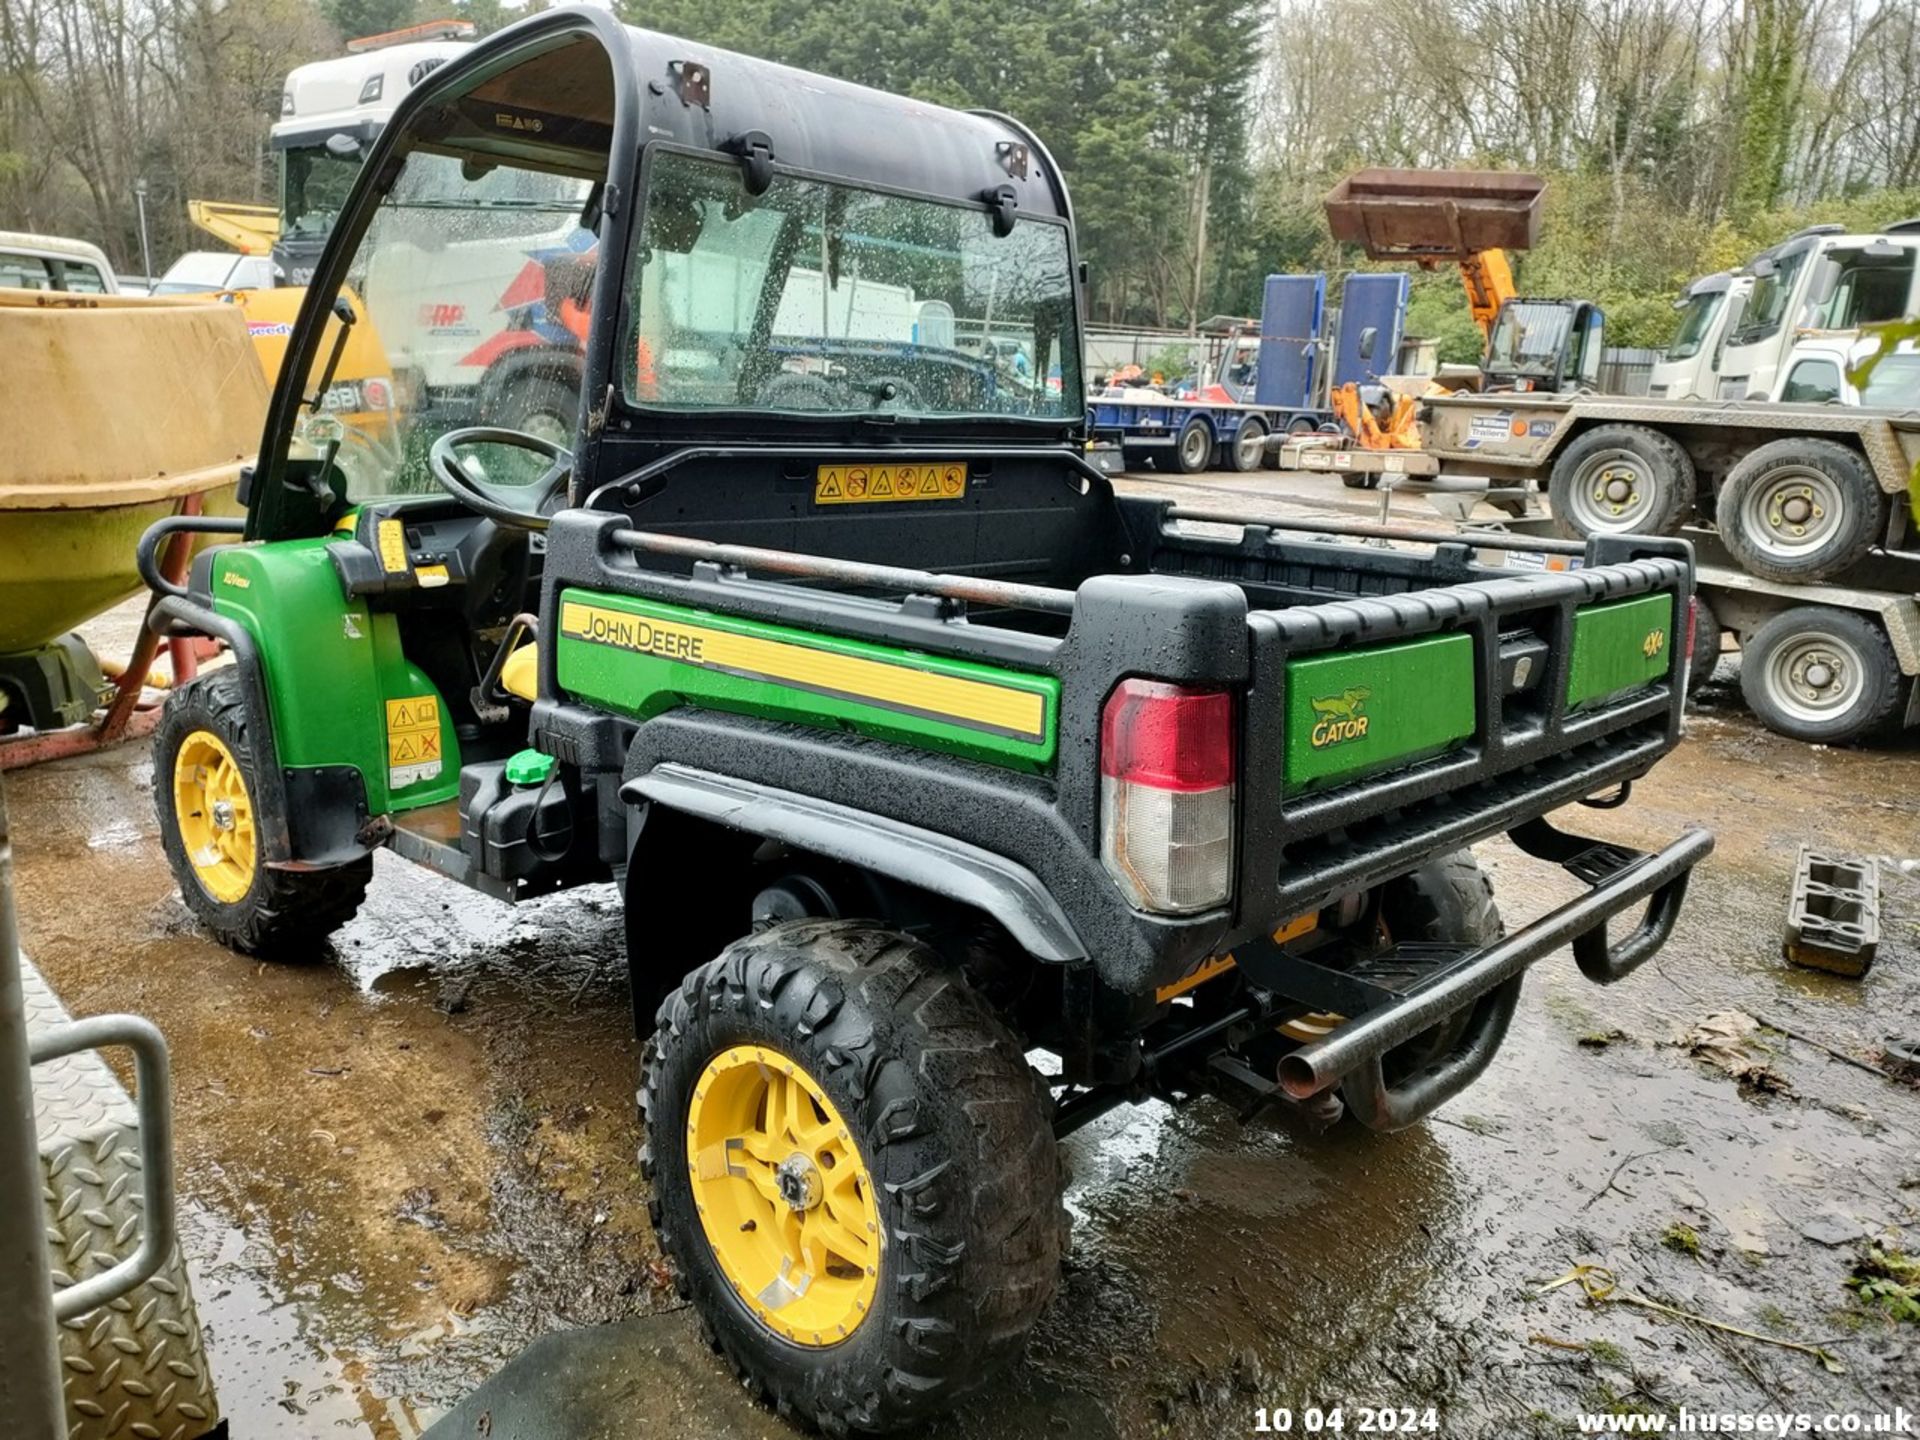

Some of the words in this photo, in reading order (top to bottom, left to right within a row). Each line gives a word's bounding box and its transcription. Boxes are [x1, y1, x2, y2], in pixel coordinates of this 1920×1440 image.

[583, 612, 633, 643] JOHN
[637, 621, 703, 659] DEERE
[1311, 716, 1369, 747] GATOR
